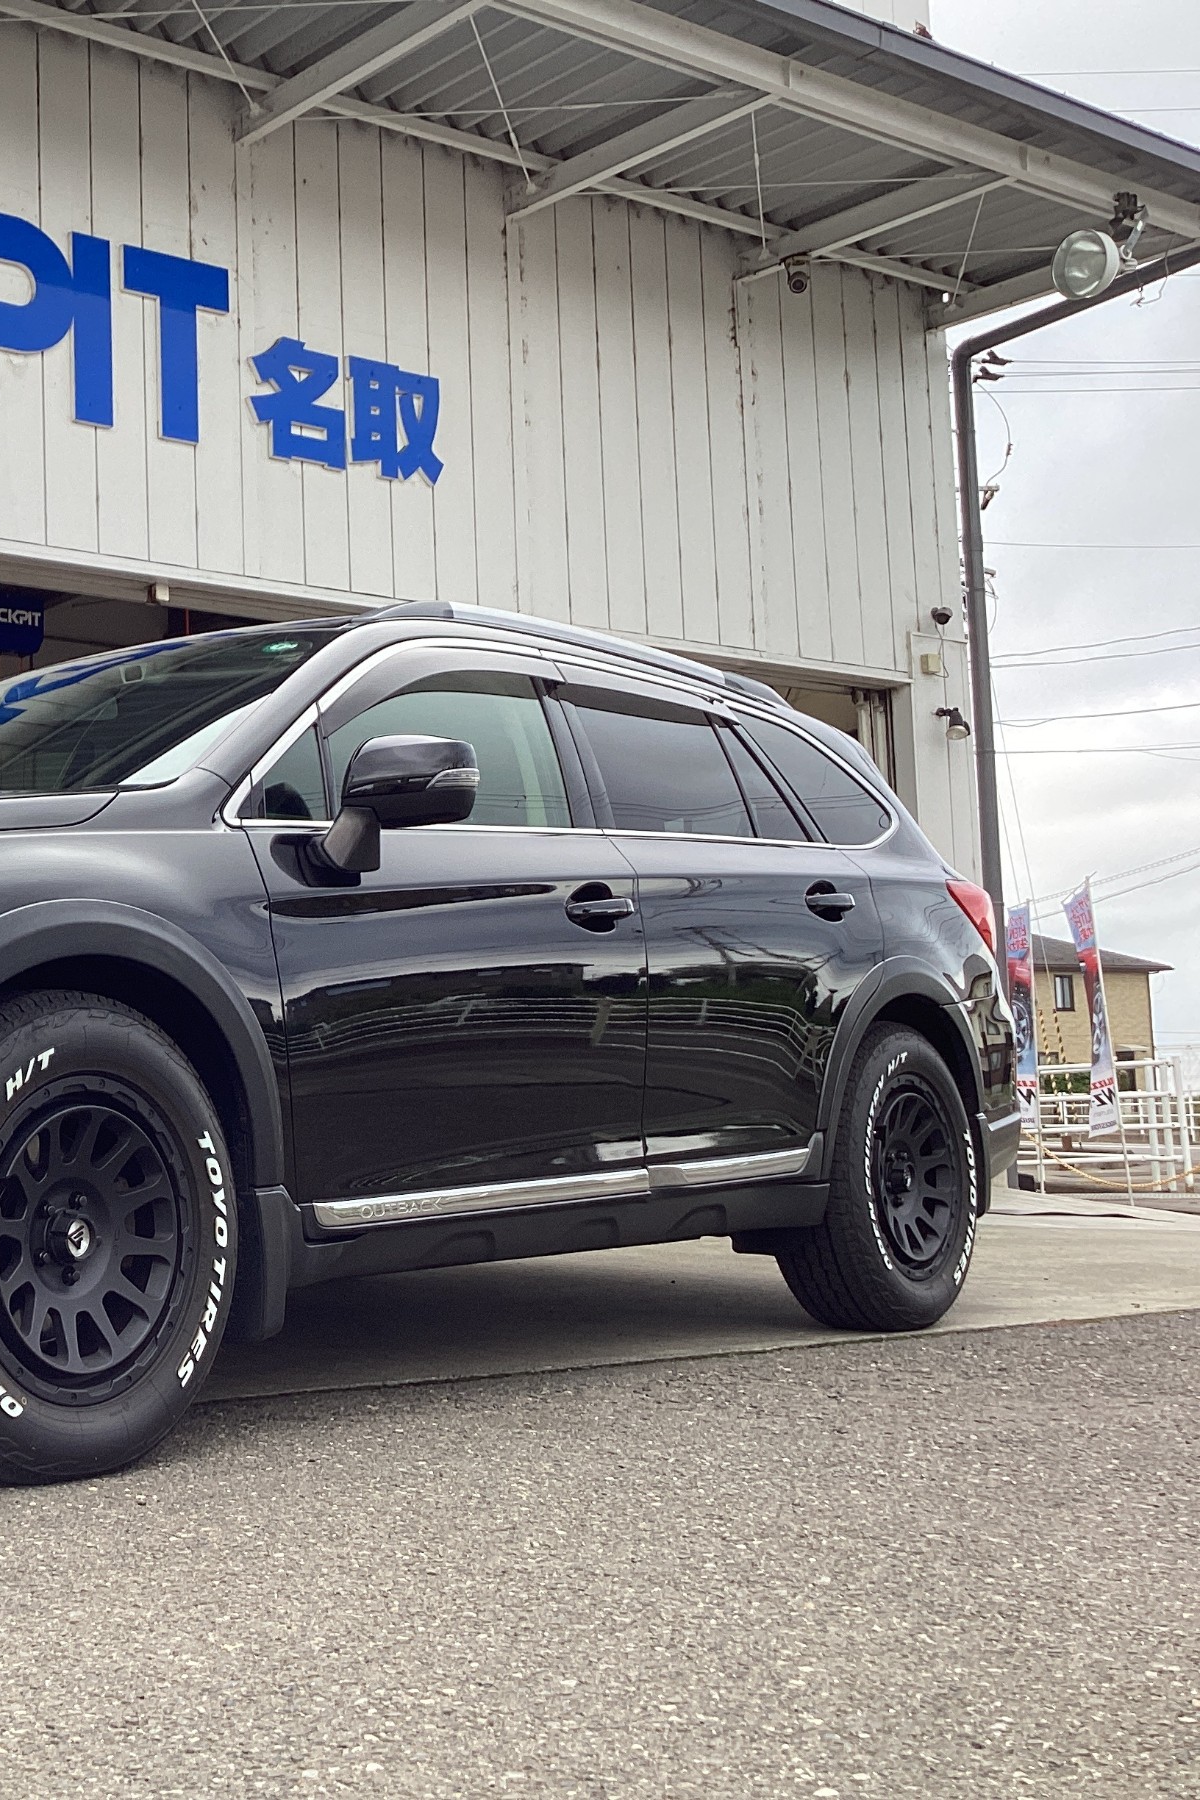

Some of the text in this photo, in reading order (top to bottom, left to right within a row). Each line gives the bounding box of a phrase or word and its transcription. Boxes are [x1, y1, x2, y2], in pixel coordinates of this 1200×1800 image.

[245, 337, 444, 487] 名取
[5, 1047, 55, 1101] H/T
[888, 1052, 907, 1076] H/T
[360, 1196, 442, 1219] OUTBACK
[953, 1128, 977, 1285] TOYO TIRES
[177, 1130, 229, 1389] TOYO TIRES
